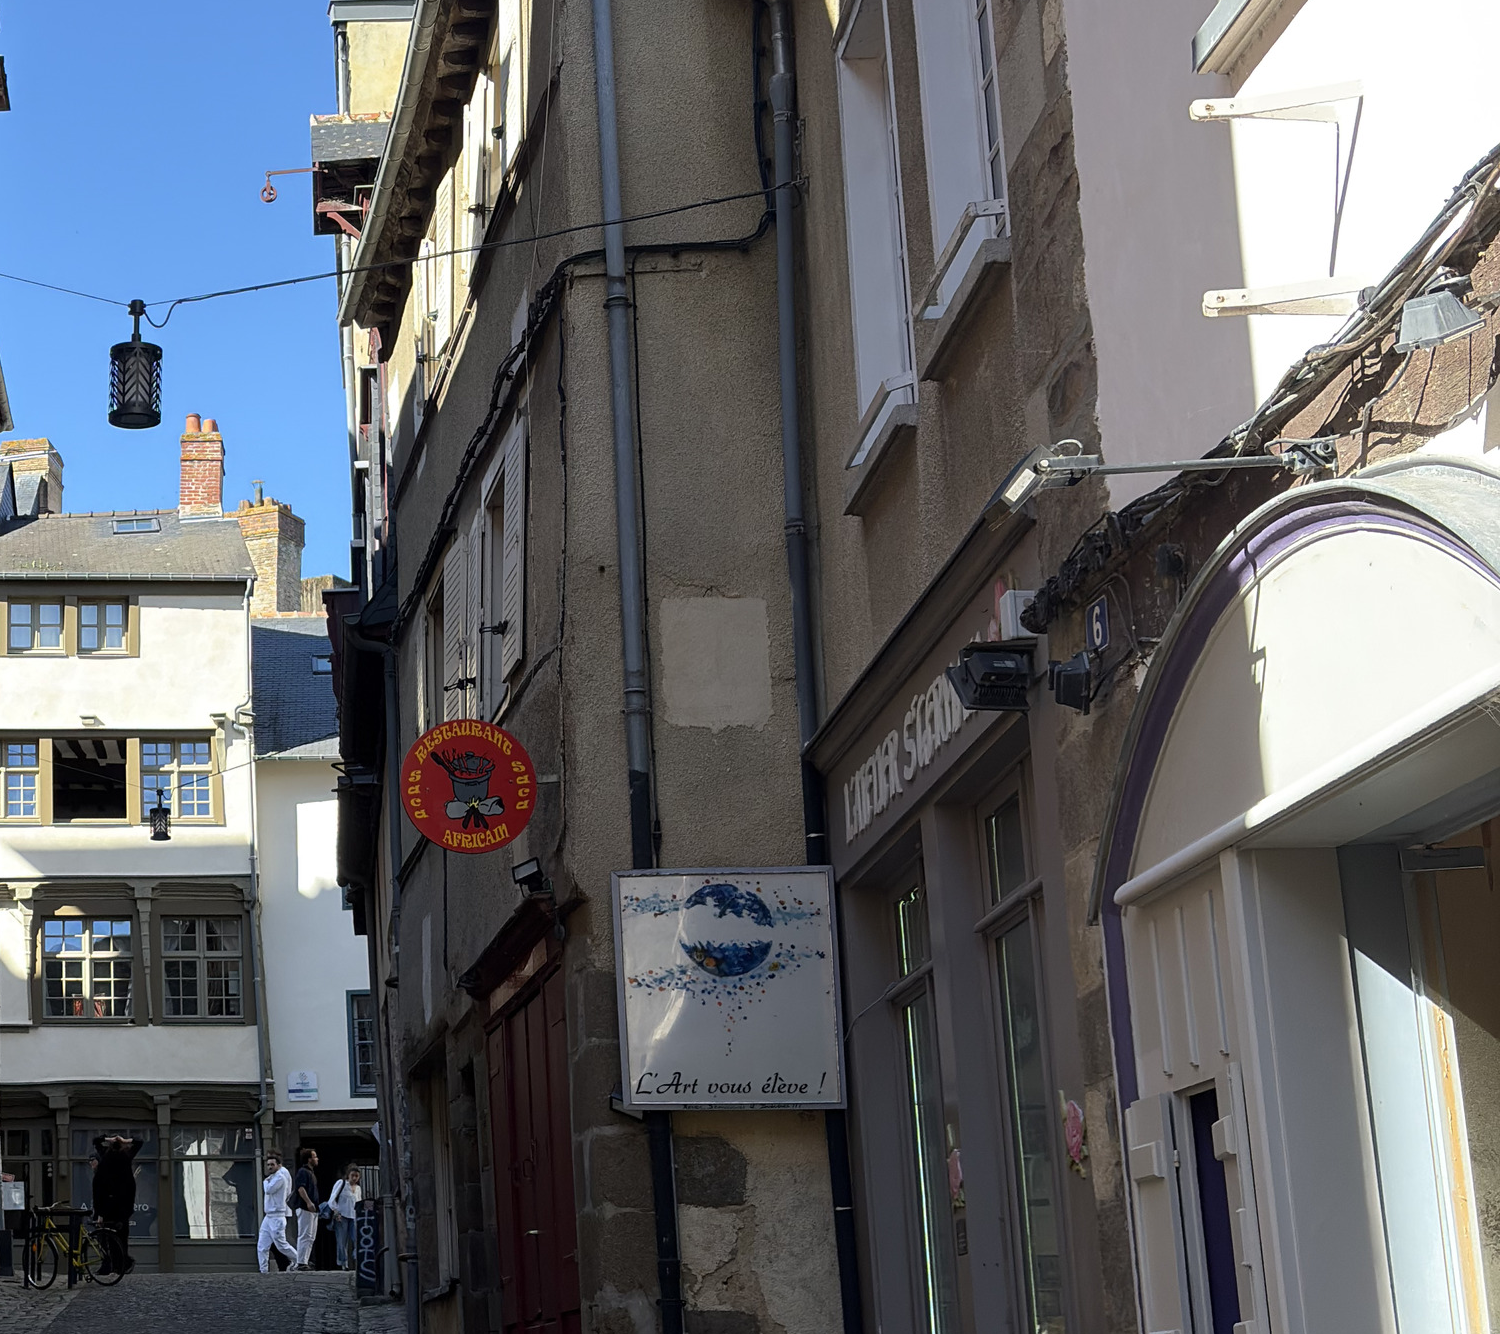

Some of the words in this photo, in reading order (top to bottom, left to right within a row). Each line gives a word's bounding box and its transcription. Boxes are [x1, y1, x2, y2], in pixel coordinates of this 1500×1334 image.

[1092, 605, 1102, 647] 6
[414, 721, 513, 765] RESTAURANT
[442, 823, 510, 849] AFRICAIN
[635, 1071, 698, 1095] L'Art
[707, 1081, 752, 1094] vous
[762, 1071, 809, 1094] élève
